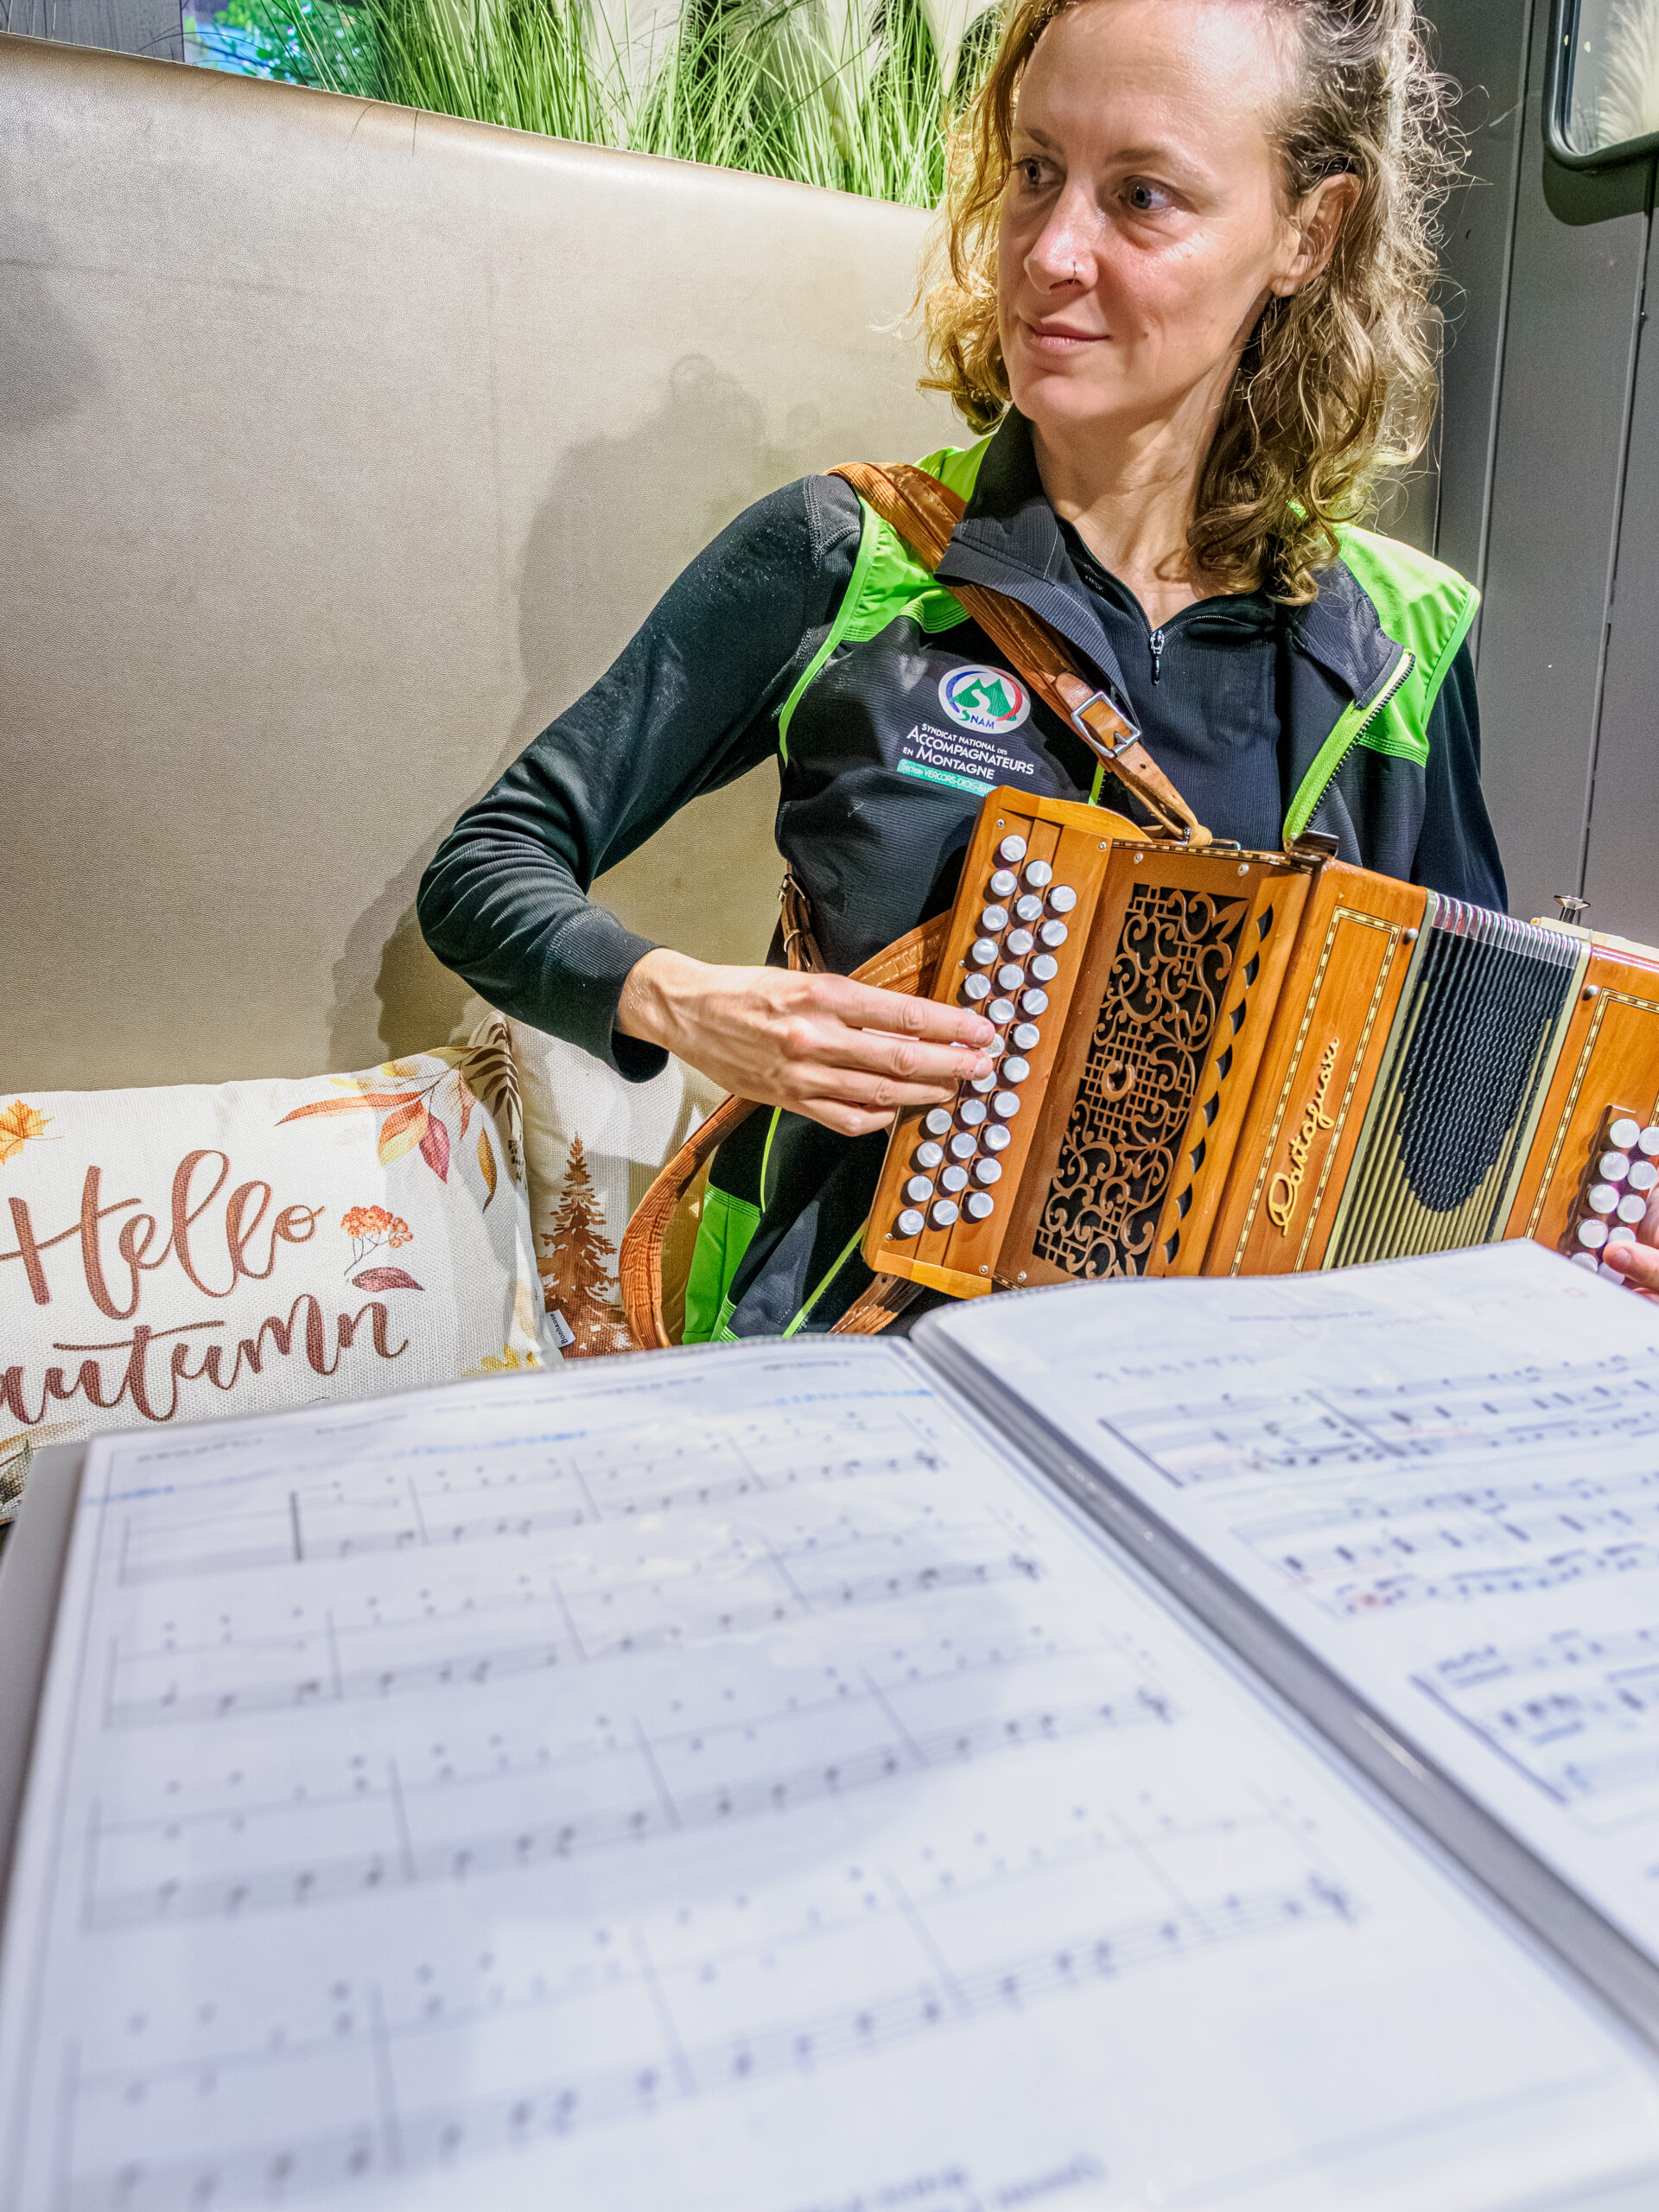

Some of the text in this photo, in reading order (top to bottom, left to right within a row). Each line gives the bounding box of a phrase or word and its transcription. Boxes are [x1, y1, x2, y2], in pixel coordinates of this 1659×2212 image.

[906, 725, 1035, 775] ACCOMPAGNATEURS
[921, 723, 957, 742] SYNDICAT
[958, 736, 995, 752] NATIONAL
[902, 745, 995, 780] EN MONTAGNE
[0, 1149, 325, 1319] Hello
[550, 1313, 569, 1344] Bonhause
